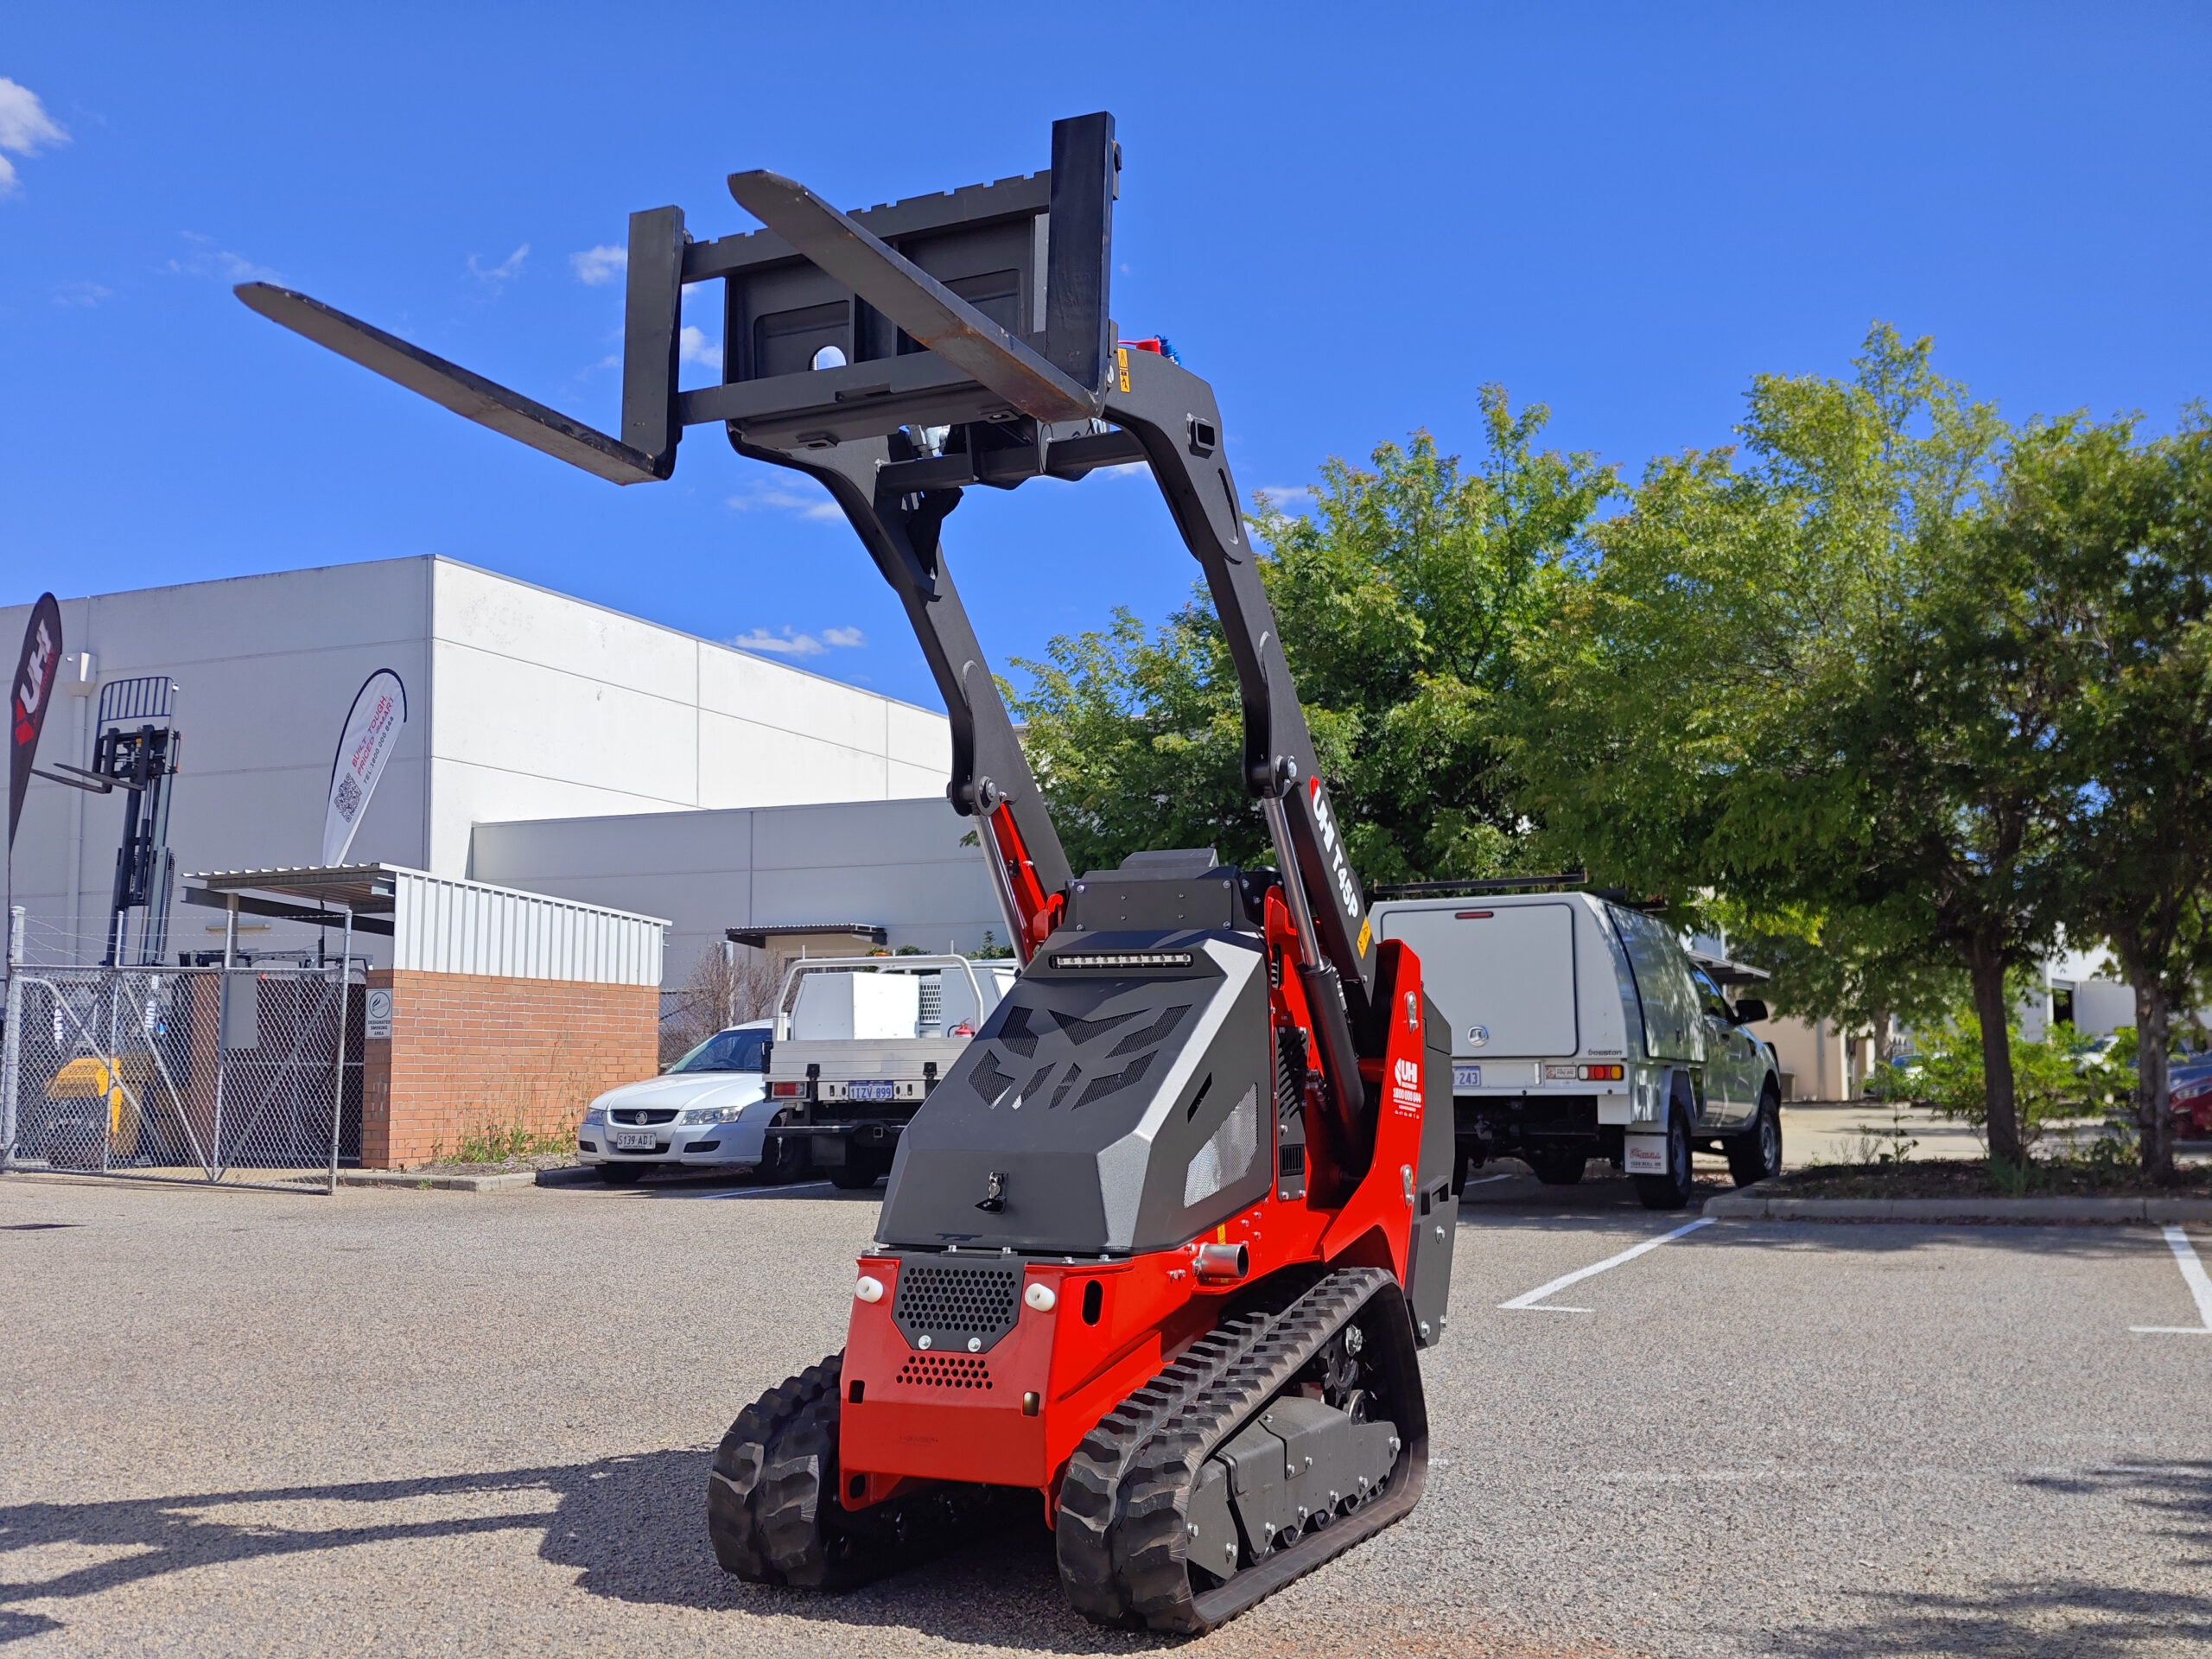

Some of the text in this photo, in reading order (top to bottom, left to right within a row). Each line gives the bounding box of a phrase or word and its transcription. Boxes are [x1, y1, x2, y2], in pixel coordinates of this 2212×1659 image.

[352, 736, 366, 768] BUILT
[358, 737, 375, 776] PRICED
[378, 732, 387, 748] 000
[1332, 843, 1359, 918] T45P
